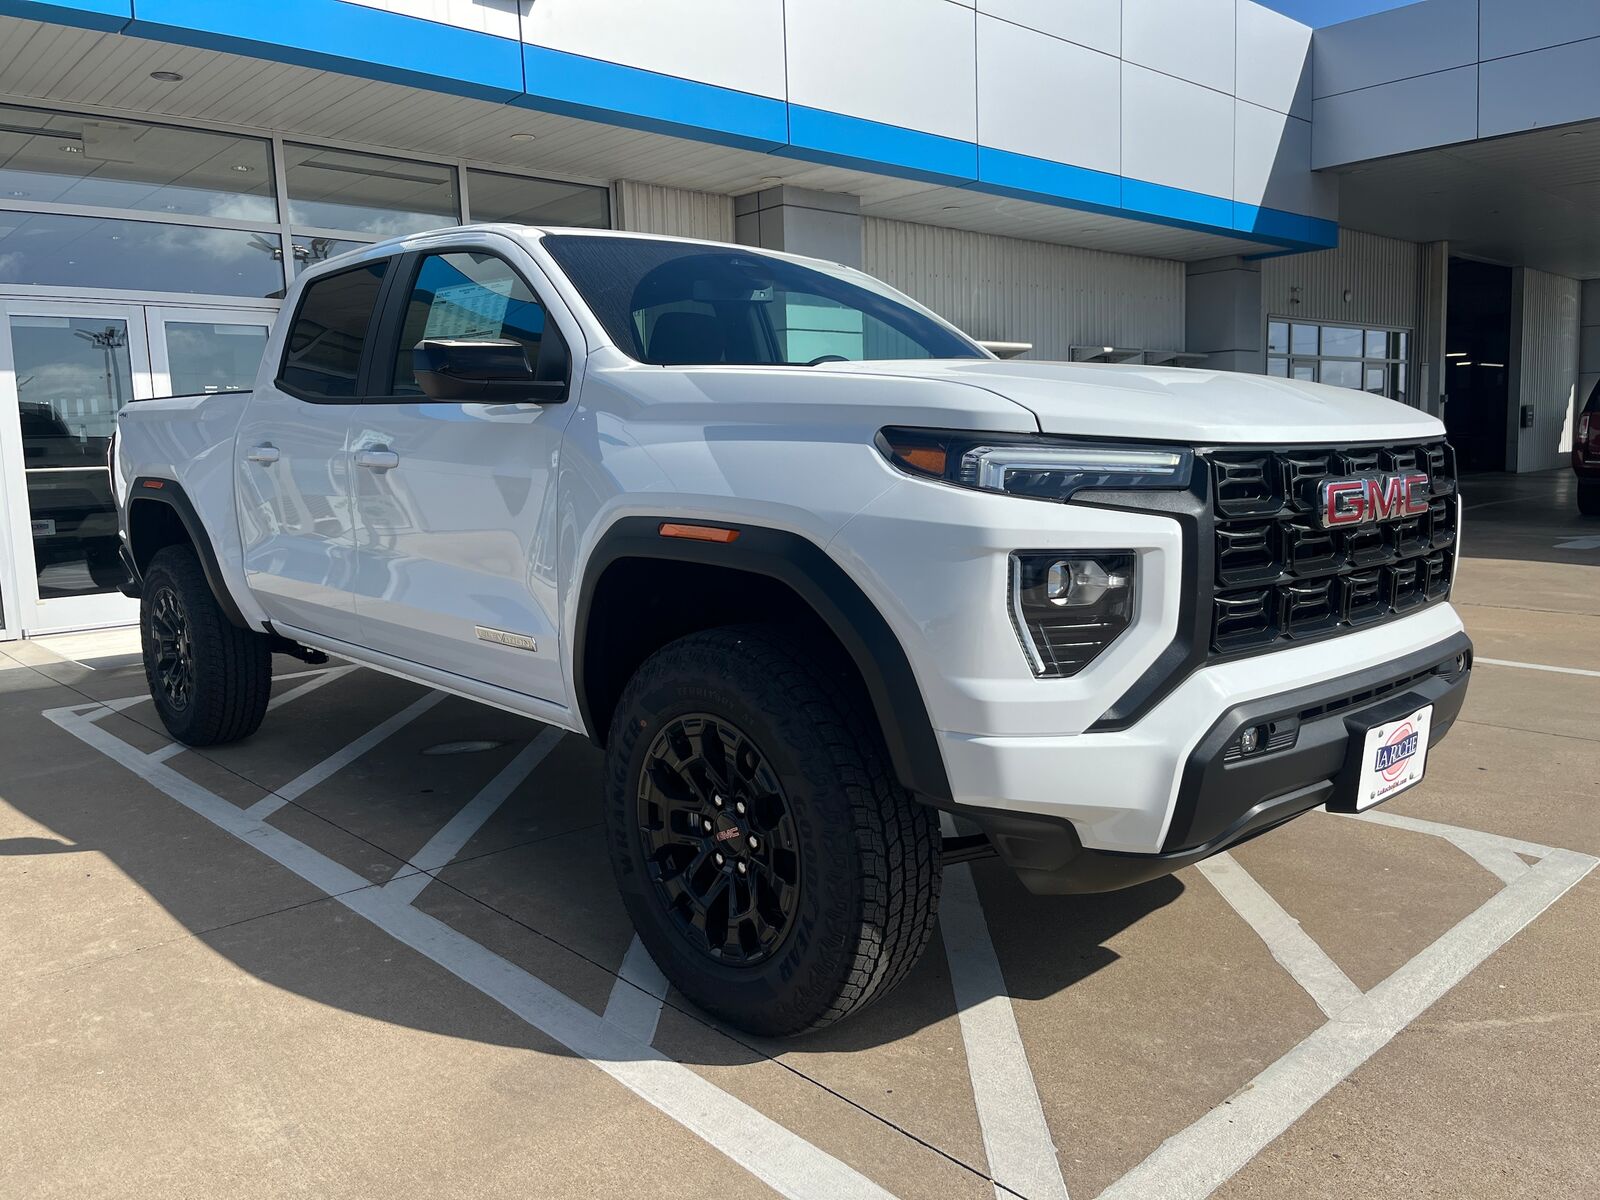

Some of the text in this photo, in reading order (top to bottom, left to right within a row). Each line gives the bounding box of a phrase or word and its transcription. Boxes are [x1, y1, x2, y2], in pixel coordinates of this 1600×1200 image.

[1325, 474, 1429, 526] GMC
[611, 716, 641, 876] WRANGLER
[716, 827, 740, 841] GMC
